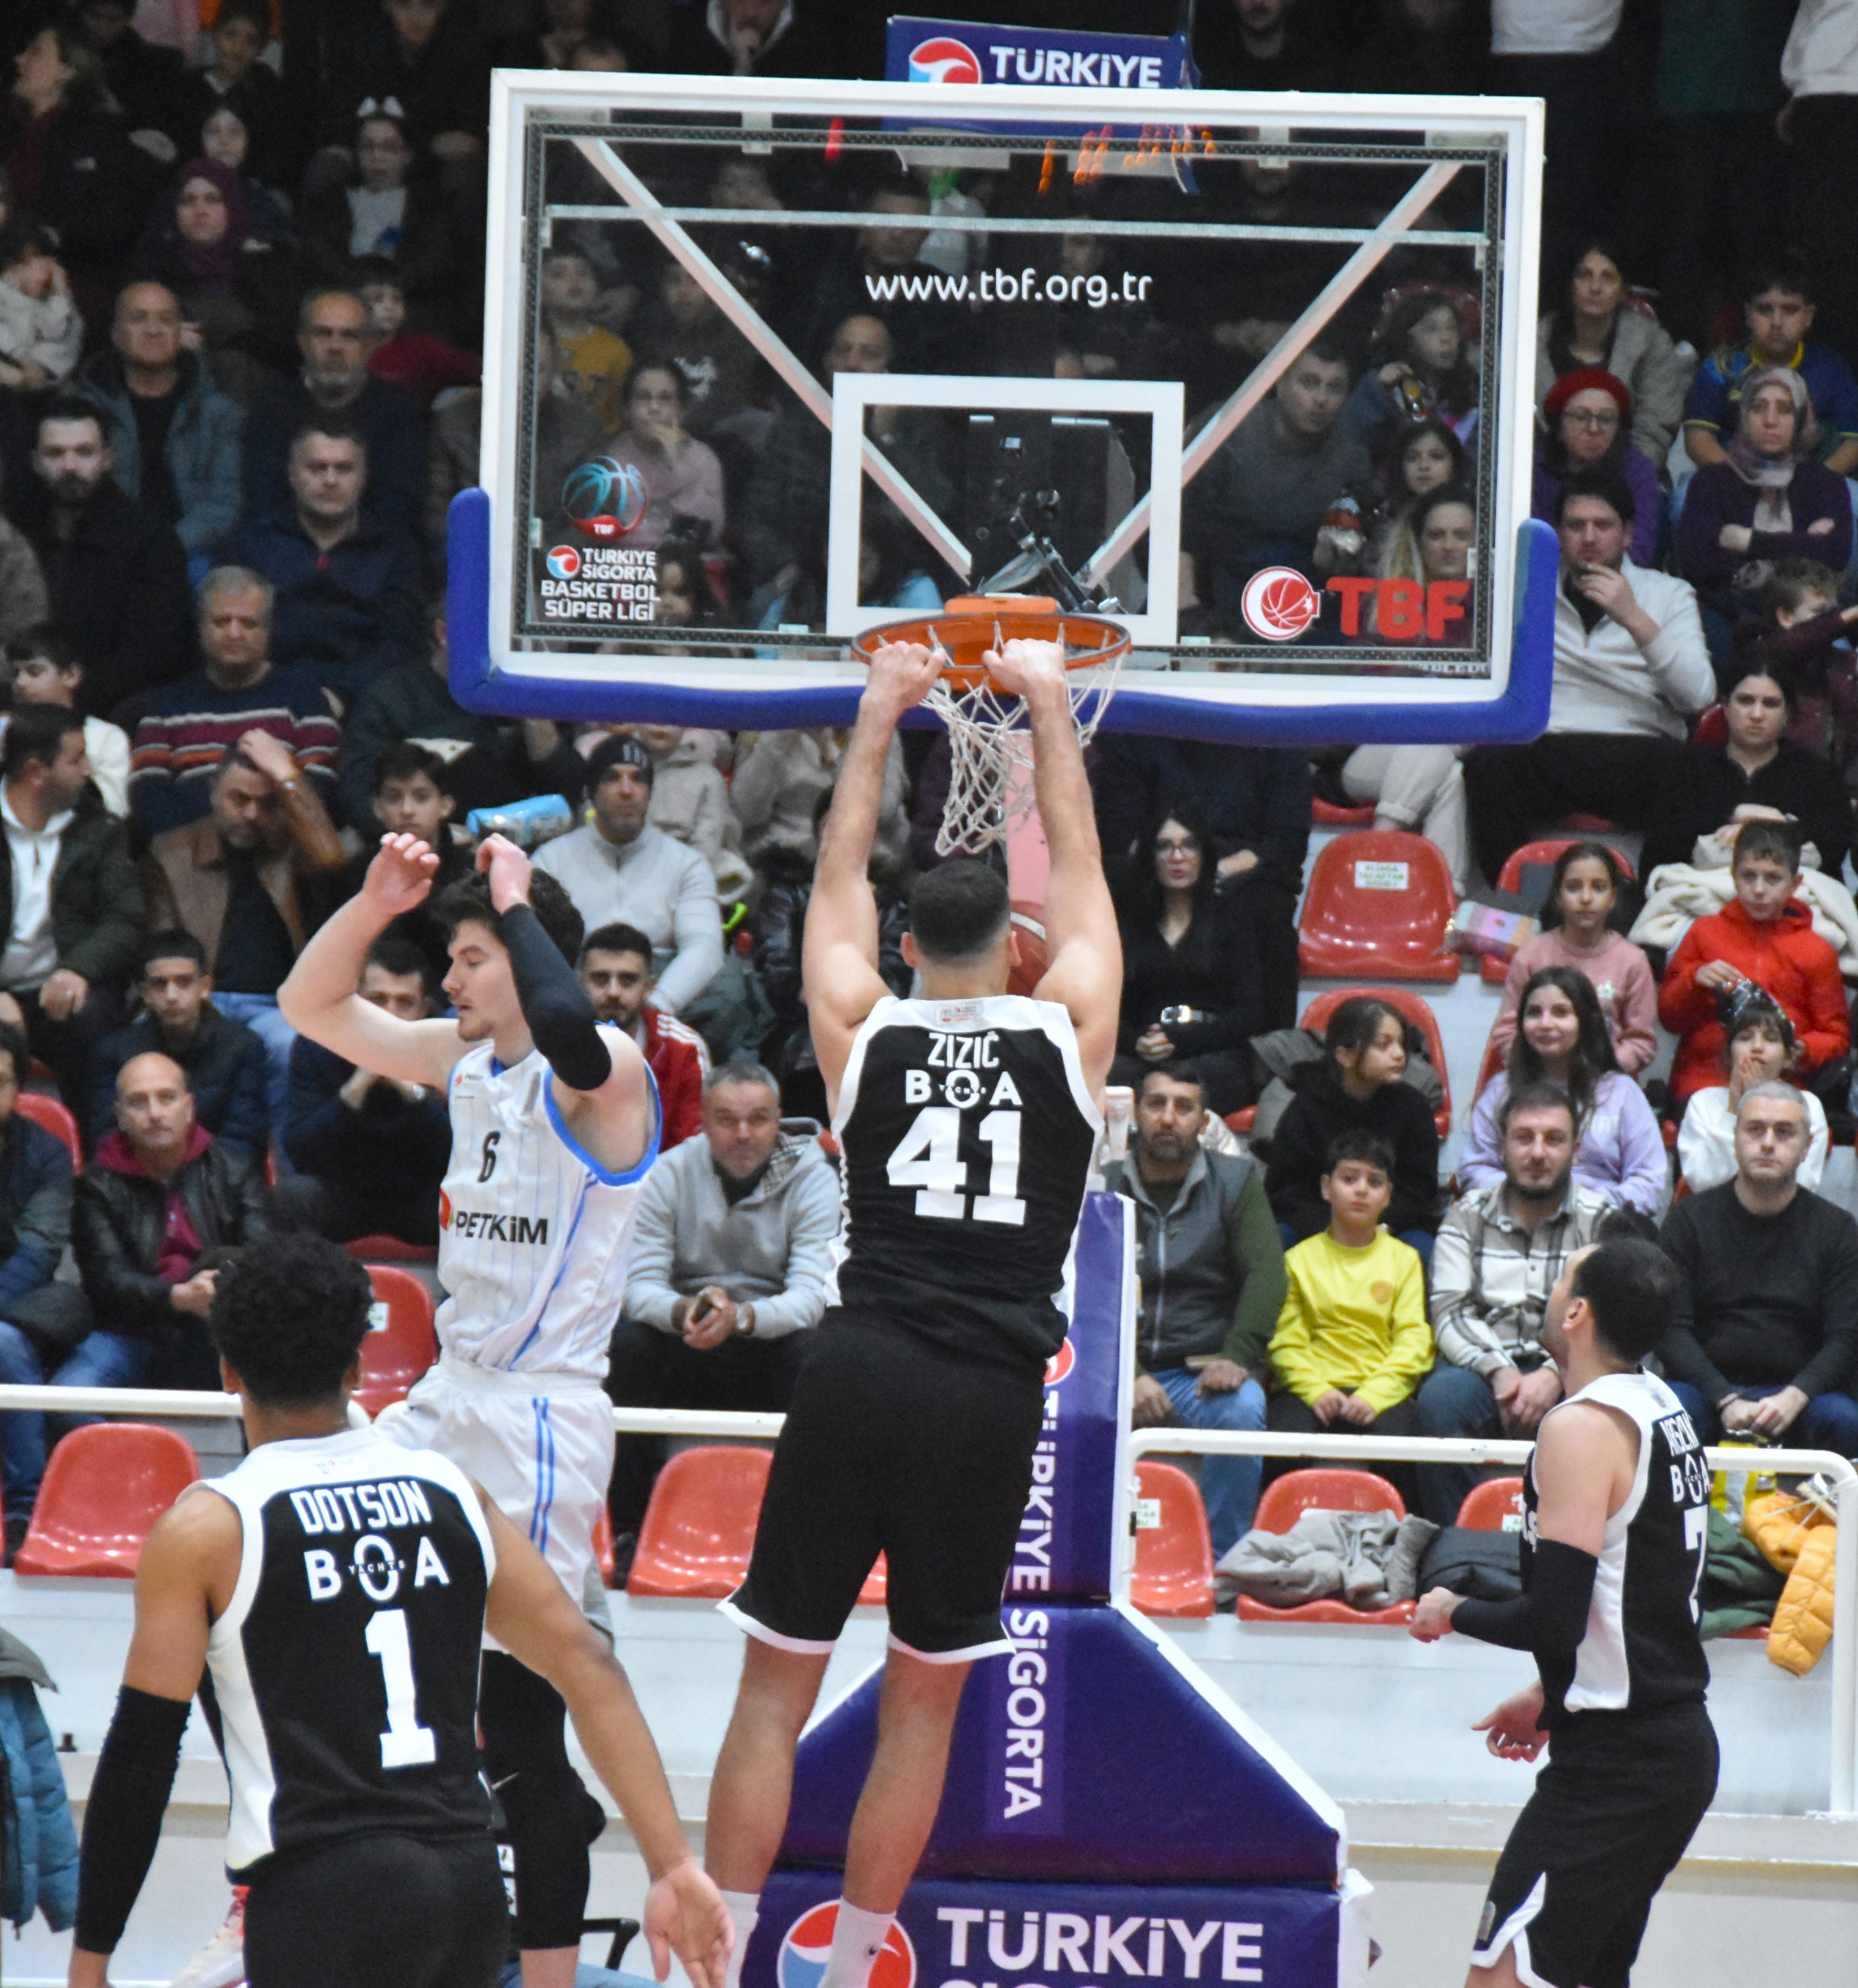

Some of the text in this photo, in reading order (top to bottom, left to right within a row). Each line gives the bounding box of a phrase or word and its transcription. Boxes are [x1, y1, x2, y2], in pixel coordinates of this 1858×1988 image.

[990, 46, 1162, 88] TÜRKİYE
[865, 267, 1153, 308] www.tbf.org.tr
[593, 523, 614, 534] TBF
[541, 580, 660, 601] BASKETBOL
[545, 598, 612, 619] SÜPER
[1326, 576, 1470, 640] TBF
[478, 1130, 501, 1183] 6
[887, 1107, 1025, 1225] 41
[289, 1481, 432, 1534] DOTSON
[1684, 1504, 1708, 1625] 7
[364, 1609, 436, 1768] 1
[1004, 1608, 1049, 1820] SİGORTA
[937, 1906, 1264, 1982] TÜRKİYE
